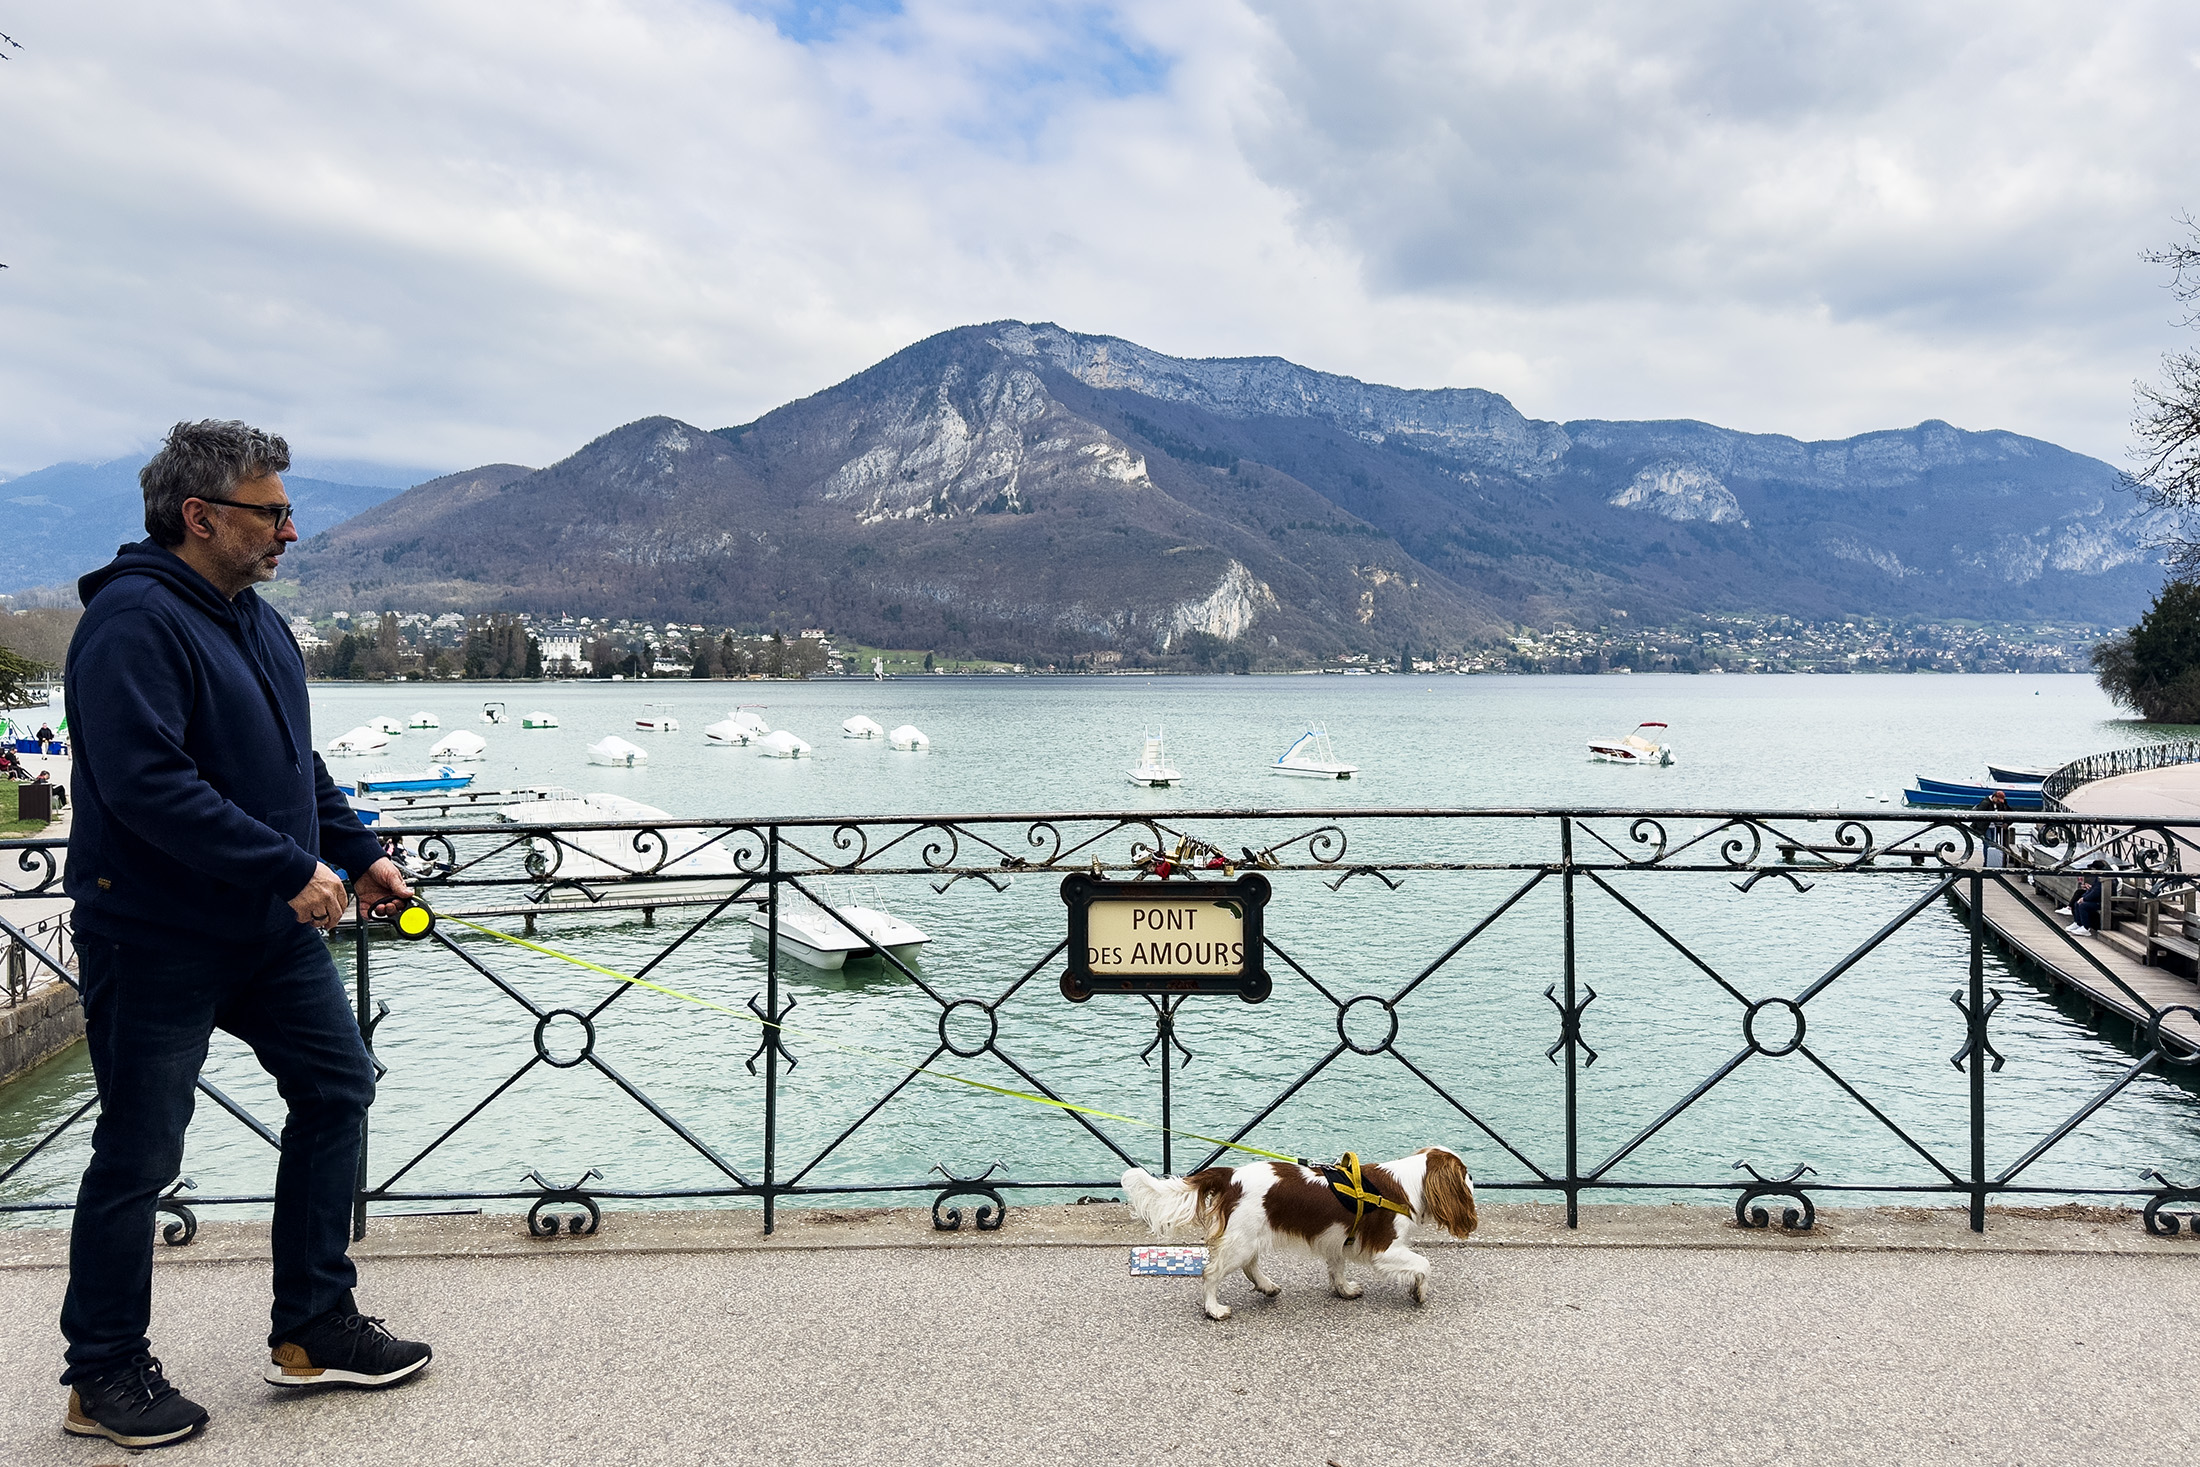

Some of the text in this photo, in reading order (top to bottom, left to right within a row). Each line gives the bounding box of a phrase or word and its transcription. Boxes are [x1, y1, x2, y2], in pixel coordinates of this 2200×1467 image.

[1133, 908, 1198, 930] PONT
[1088, 942, 1245, 966] DES AMOURS
